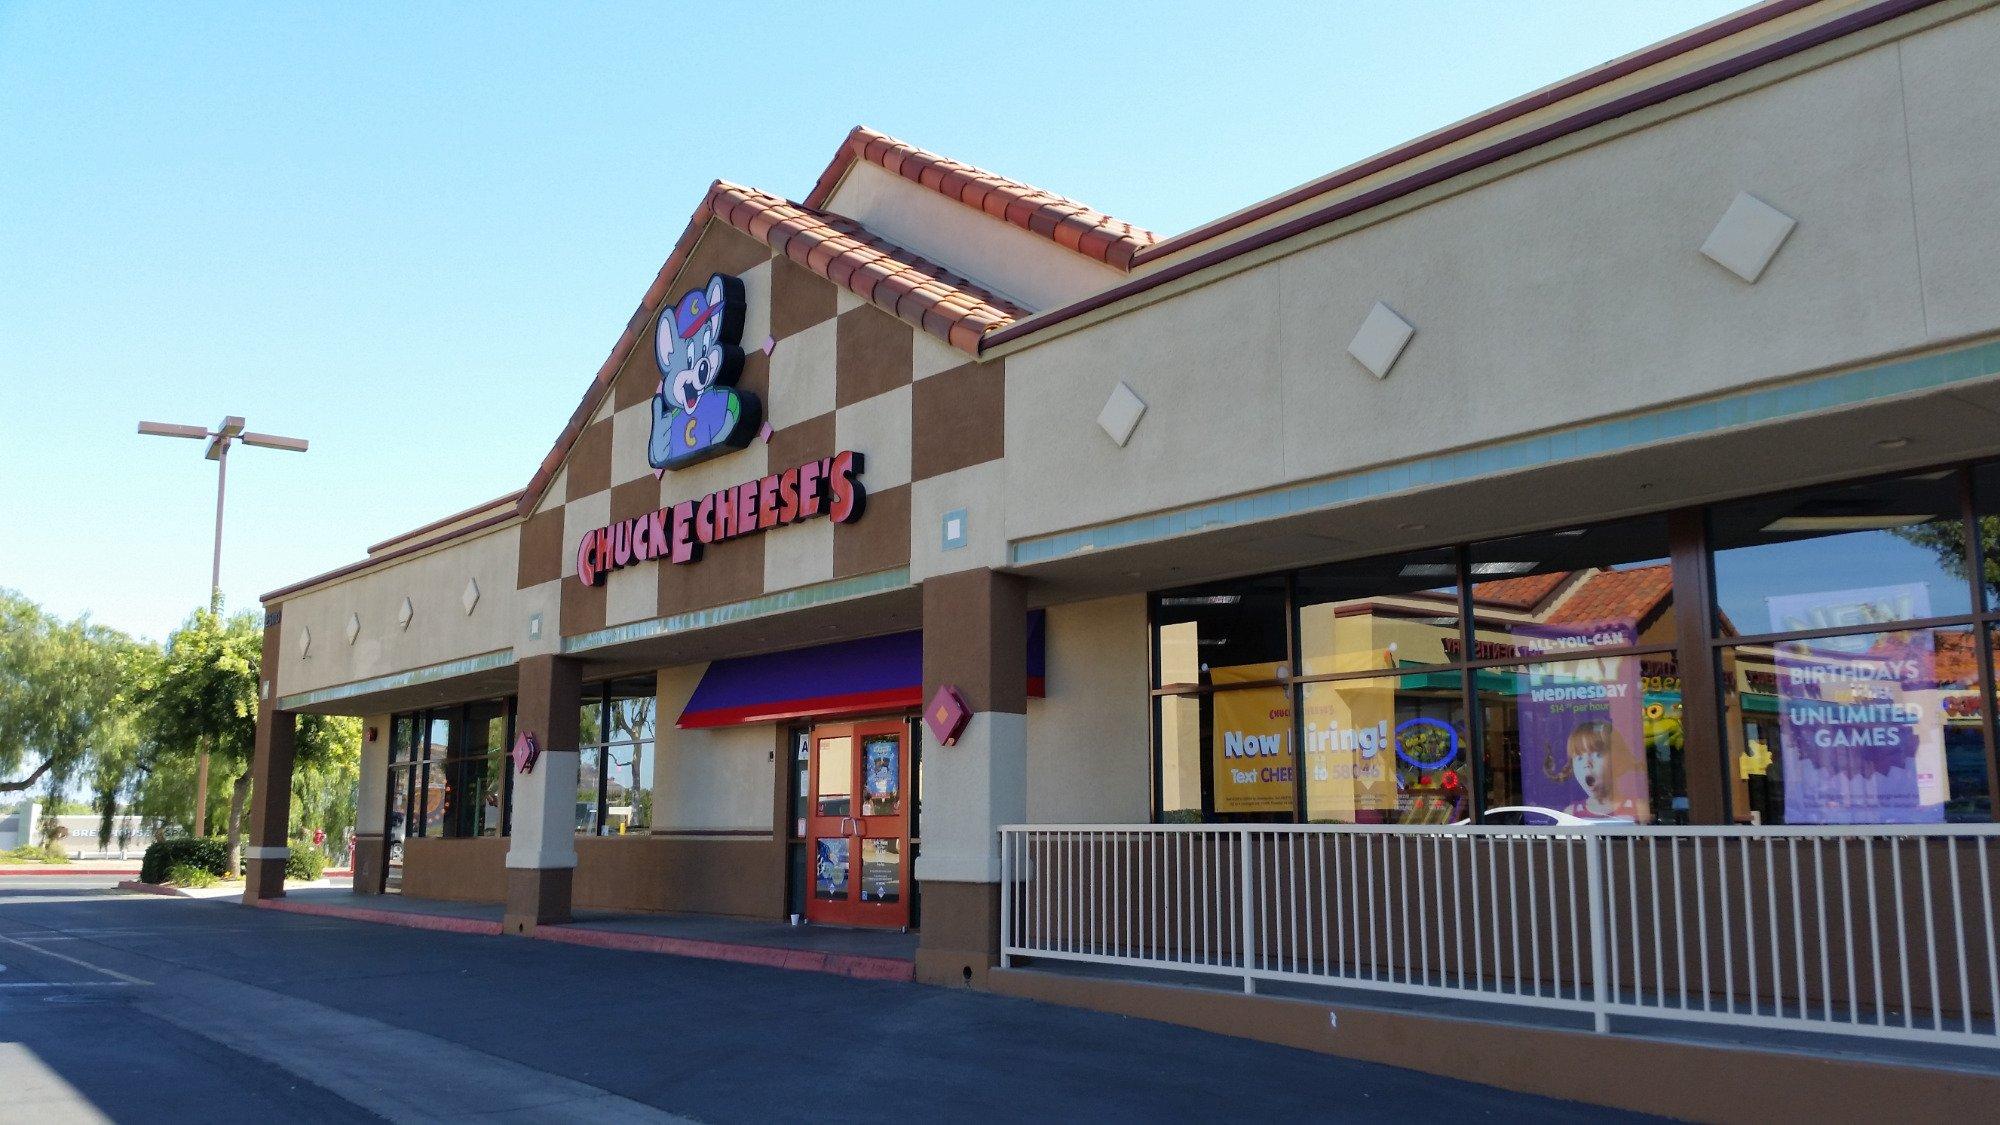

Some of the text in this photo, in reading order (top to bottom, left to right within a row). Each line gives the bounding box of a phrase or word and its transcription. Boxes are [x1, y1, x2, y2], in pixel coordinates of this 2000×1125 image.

[684, 417, 698, 448] C
[576, 450, 860, 587] CHUCK E CHEESE'S
[1528, 632, 1624, 652] ALL-YOU-CAN
[1529, 655, 1623, 686] PLAY
[1789, 660, 1920, 686] BIRTHDAYS
[1269, 709, 1291, 720] CHUC
[1789, 702, 1924, 726] UNLIMITED
[801, 741, 809, 752] A
[1224, 729, 1281, 759] Now
[1814, 727, 1900, 748] GAMES
[1231, 768, 1258, 784] Text
[1260, 767, 1293, 783] CHEE
